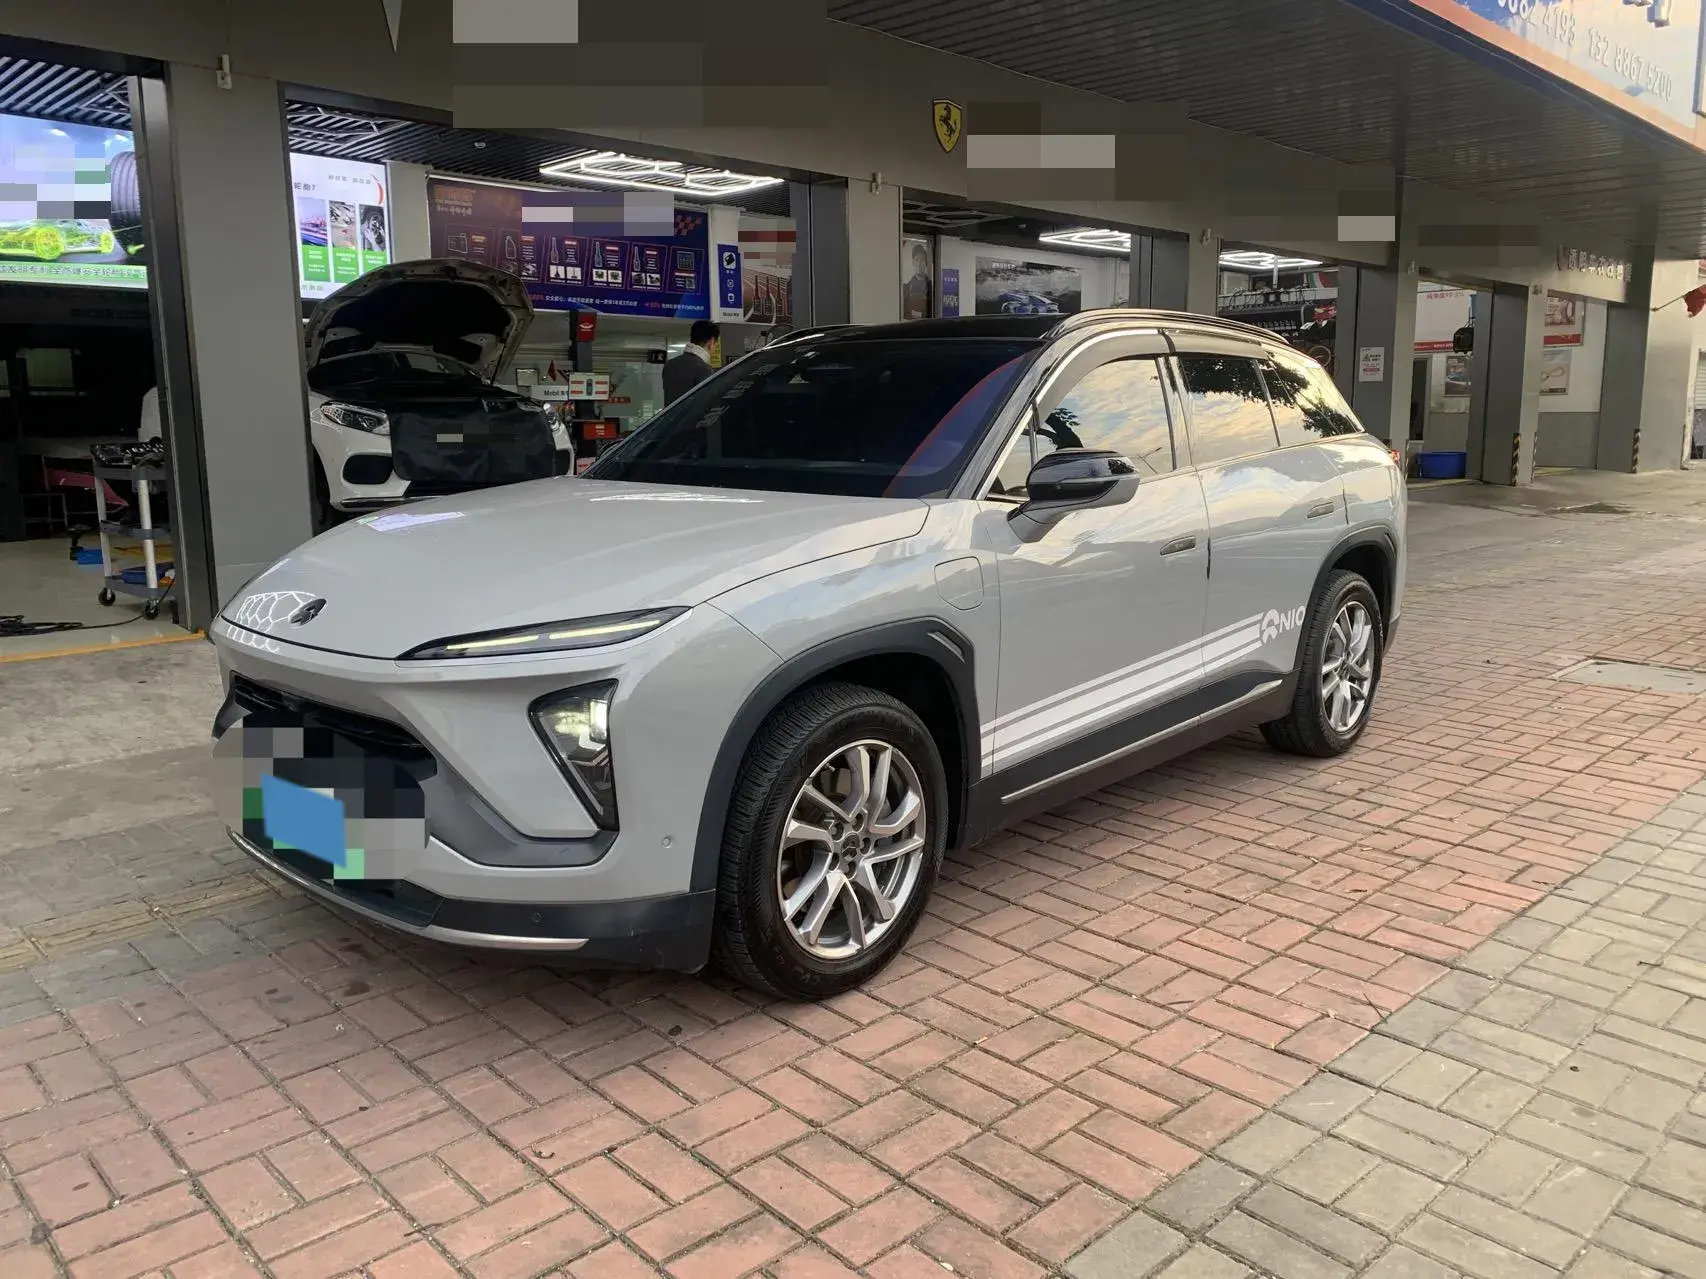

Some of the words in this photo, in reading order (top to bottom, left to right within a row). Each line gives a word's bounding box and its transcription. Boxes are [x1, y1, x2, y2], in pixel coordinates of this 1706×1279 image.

[1543, 1, 1576, 47] 4193
[1588, 26, 1609, 67] 132
[1615, 41, 1644, 84] 8867
[1279, 605, 1306, 633] NIO
